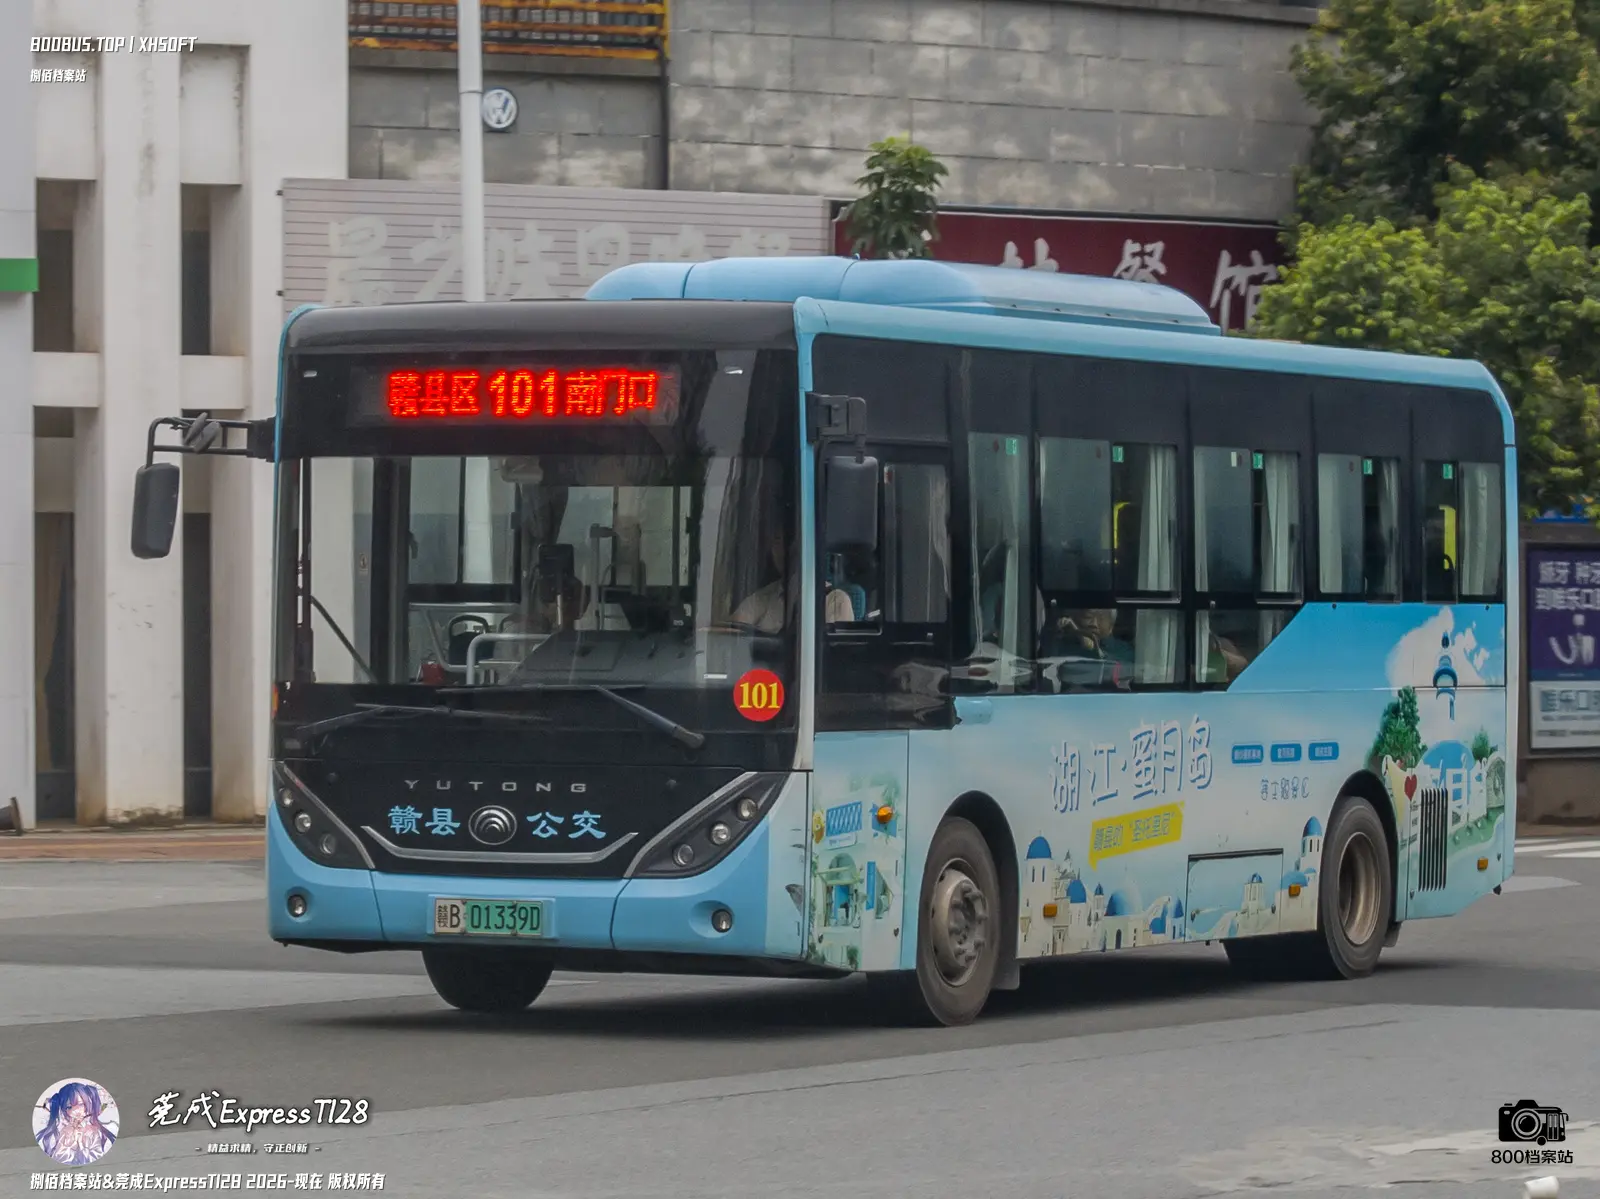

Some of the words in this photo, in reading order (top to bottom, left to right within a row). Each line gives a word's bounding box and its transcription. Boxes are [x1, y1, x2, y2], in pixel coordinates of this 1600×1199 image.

[388, 369, 480, 417] 赣县区
[488, 369, 558, 417] 101
[565, 368, 659, 416] 南门口
[739, 682, 780, 709] 101
[404, 779, 588, 793] YUTONG
[388, 805, 461, 836] 赣县
[526, 810, 607, 839] 公交
[470, 904, 541, 931] 01339D
